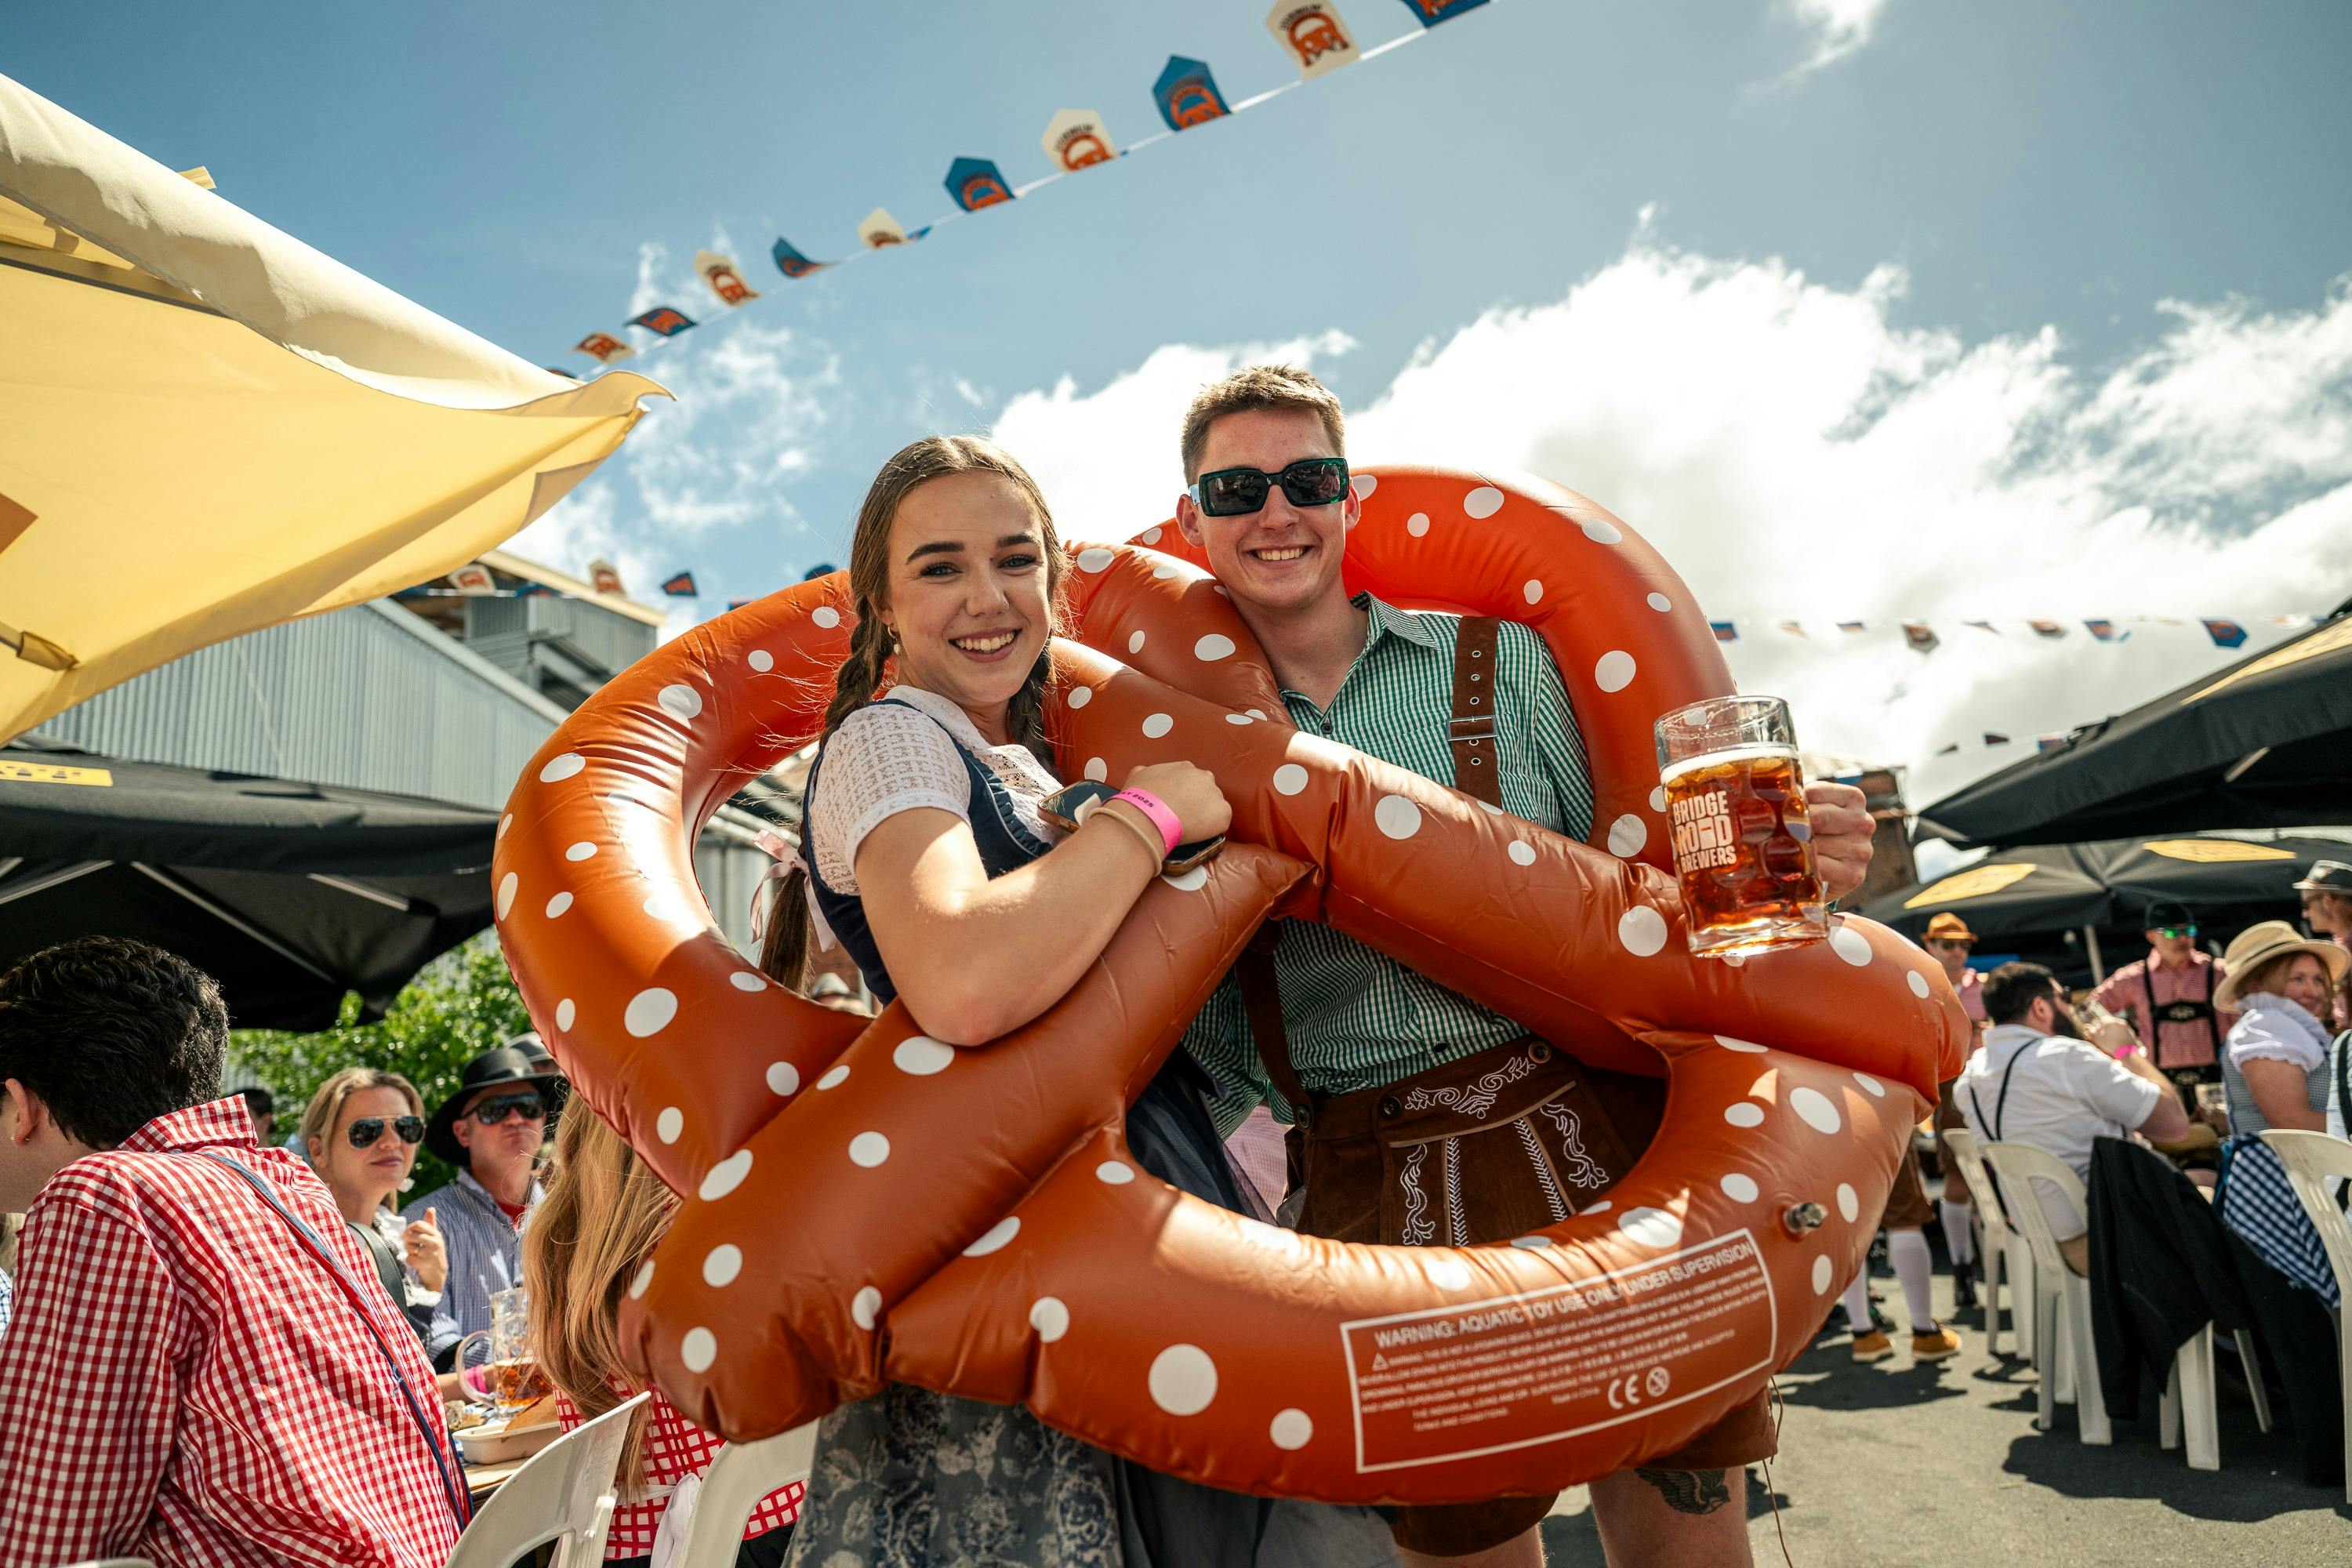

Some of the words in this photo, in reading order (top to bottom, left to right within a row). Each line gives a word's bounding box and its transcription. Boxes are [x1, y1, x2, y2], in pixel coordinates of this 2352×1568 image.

[1132, 794, 1154, 808] 2025
[1672, 790, 1730, 826] BRIDGE
[1680, 845, 1737, 873] BREWERS
[1374, 1320, 1457, 1349] WARNING:
[1459, 1306, 1525, 1334] AQUATIC
[1522, 1300, 1555, 1319] TOY
[1554, 1293, 1589, 1314] USE
[1585, 1282, 1624, 1306] ONLY
[1624, 1270, 1673, 1296] UNDER
[1668, 1241, 1755, 1283] SUPERVISION
[1608, 1374, 1641, 1410] CE
